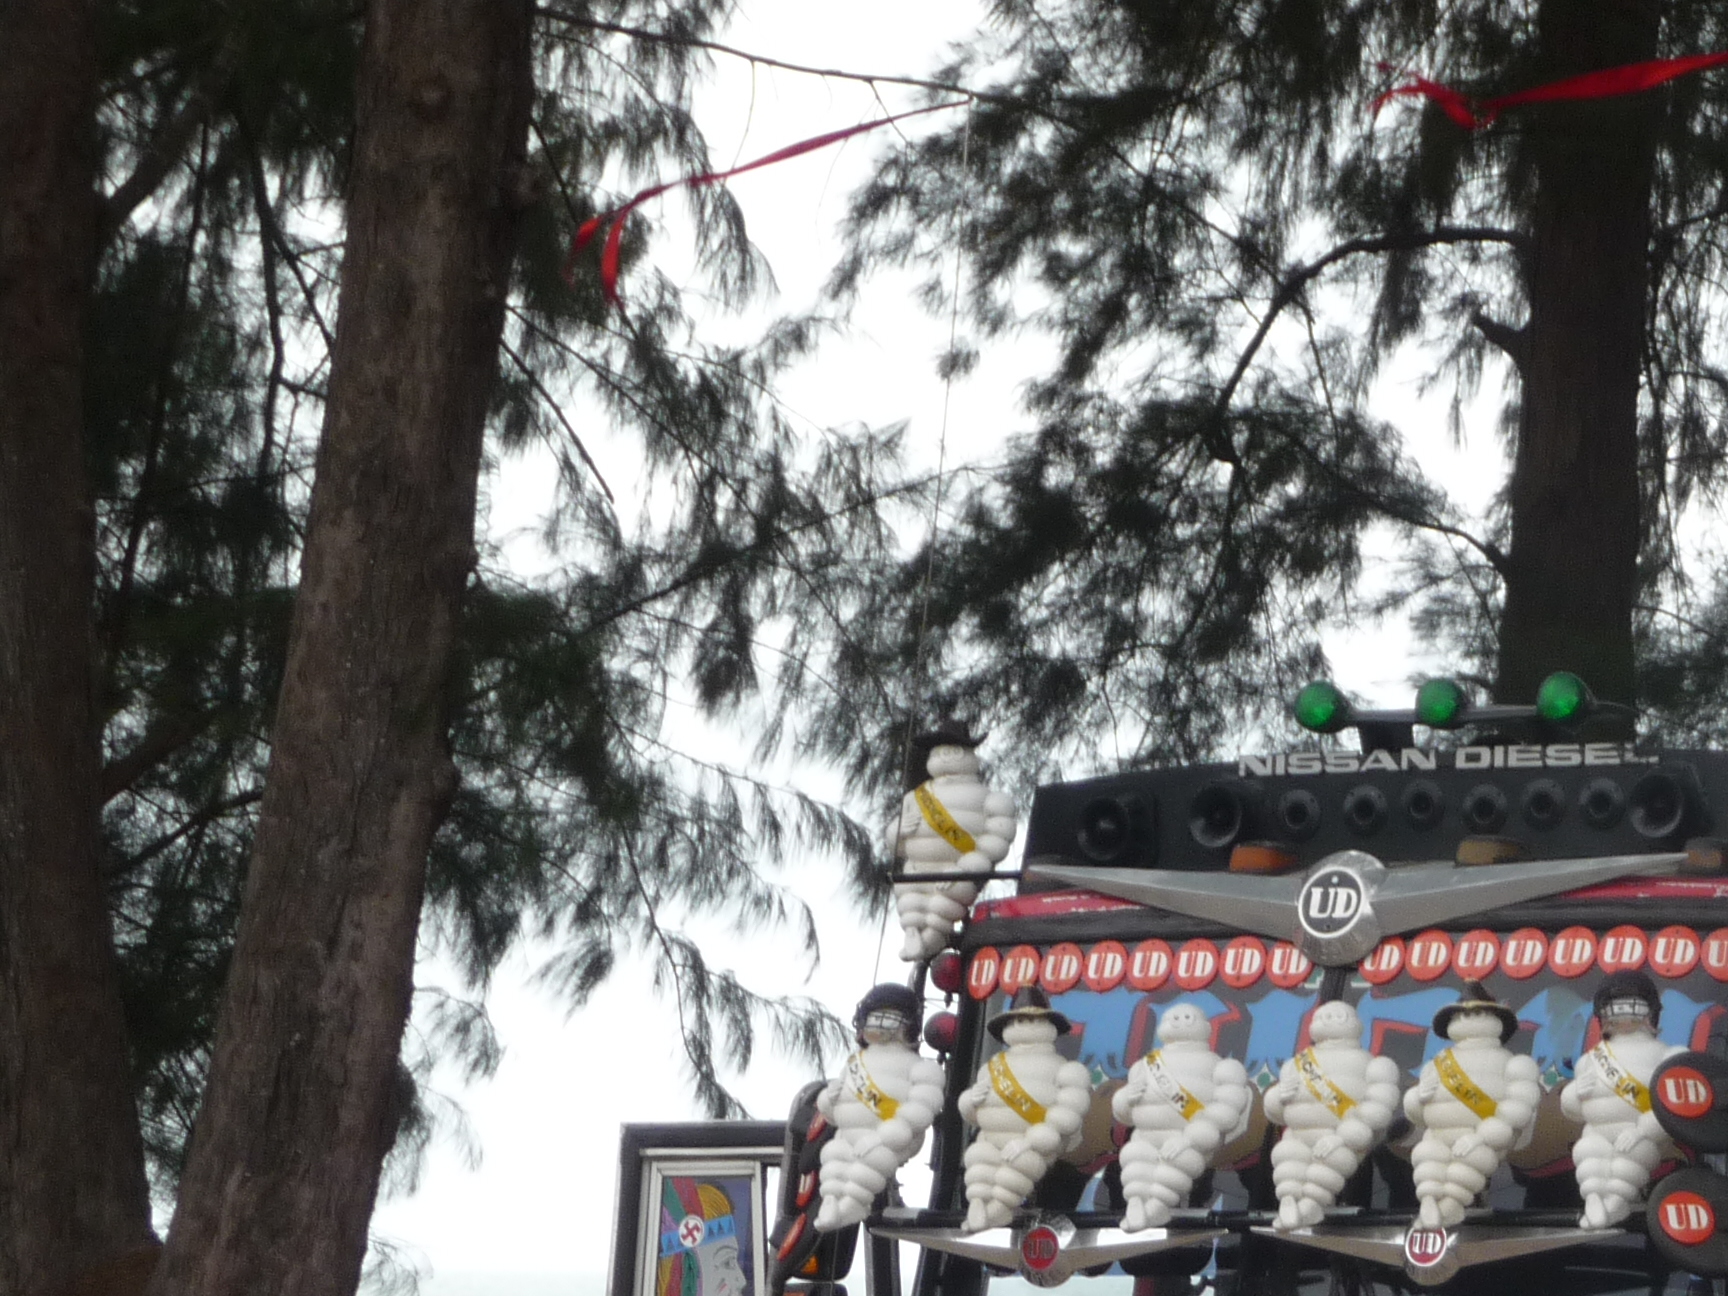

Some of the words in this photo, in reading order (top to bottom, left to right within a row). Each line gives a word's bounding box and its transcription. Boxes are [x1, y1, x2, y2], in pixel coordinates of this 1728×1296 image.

[1239, 748, 1437, 777] NISSAN
[1455, 744, 1658, 769] DIESEL
[1309, 887, 1357, 918] UD
[971, 958, 995, 987] UD
[1003, 958, 1034, 982] UD
[1045, 955, 1077, 980] UD
[1088, 953, 1122, 978] UD
[1133, 951, 1167, 976] UD
[1179, 951, 1212, 976] UD
[1225, 949, 1260, 974] UD
[1272, 949, 1306, 974] UD
[1363, 945, 1399, 970] UD
[1410, 943, 1447, 967] UD
[1458, 942, 1494, 967] UD
[1506, 941, 1542, 965] UD
[1555, 940, 1592, 964] UD
[1604, 938, 1643, 963] UD
[1655, 938, 1694, 964] UD
[1665, 1078, 1706, 1104] UD
[1666, 1204, 1708, 1230] UD
[1413, 1233, 1441, 1254] UD
